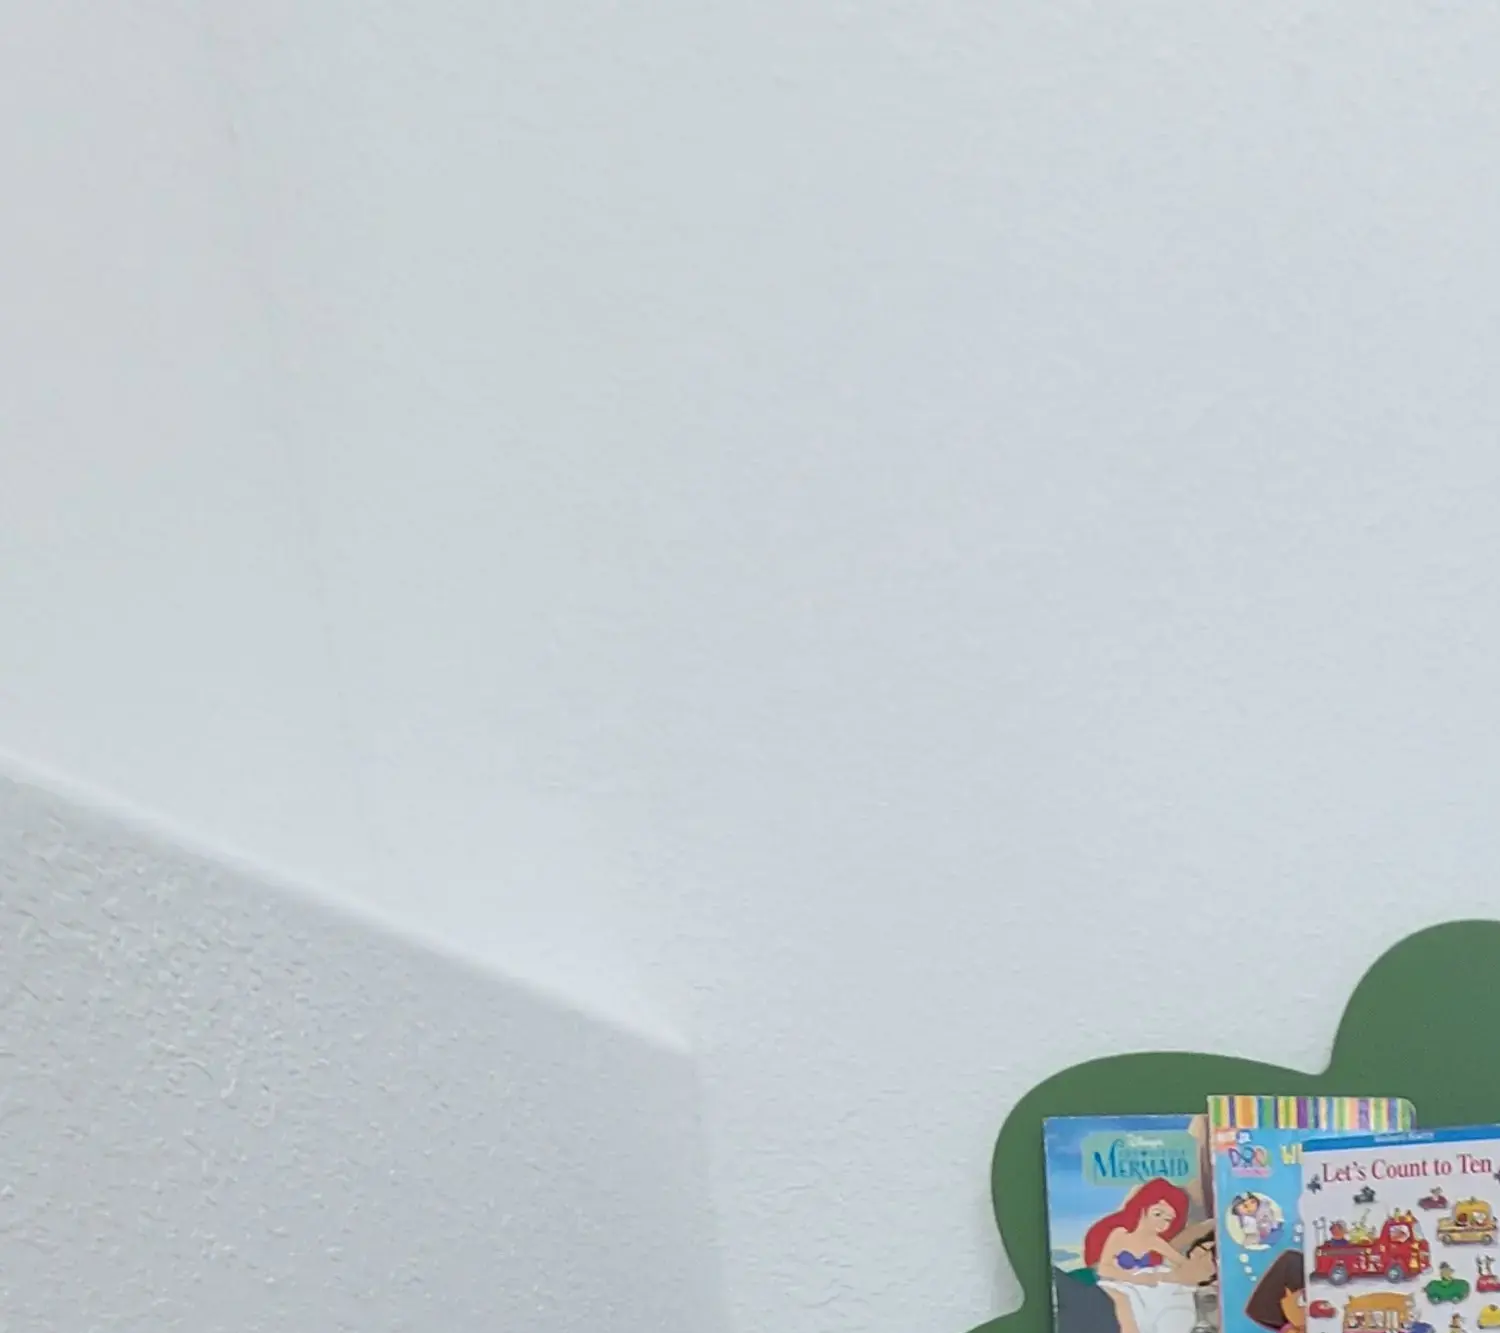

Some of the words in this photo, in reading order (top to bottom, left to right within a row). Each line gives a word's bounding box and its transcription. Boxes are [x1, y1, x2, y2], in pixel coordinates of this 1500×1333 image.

[1322, 1161, 1367, 1183] Let's
[1371, 1159, 1427, 1178] Count
[1433, 1158, 1451, 1174] to
[1456, 1152, 1492, 1174] Ten
